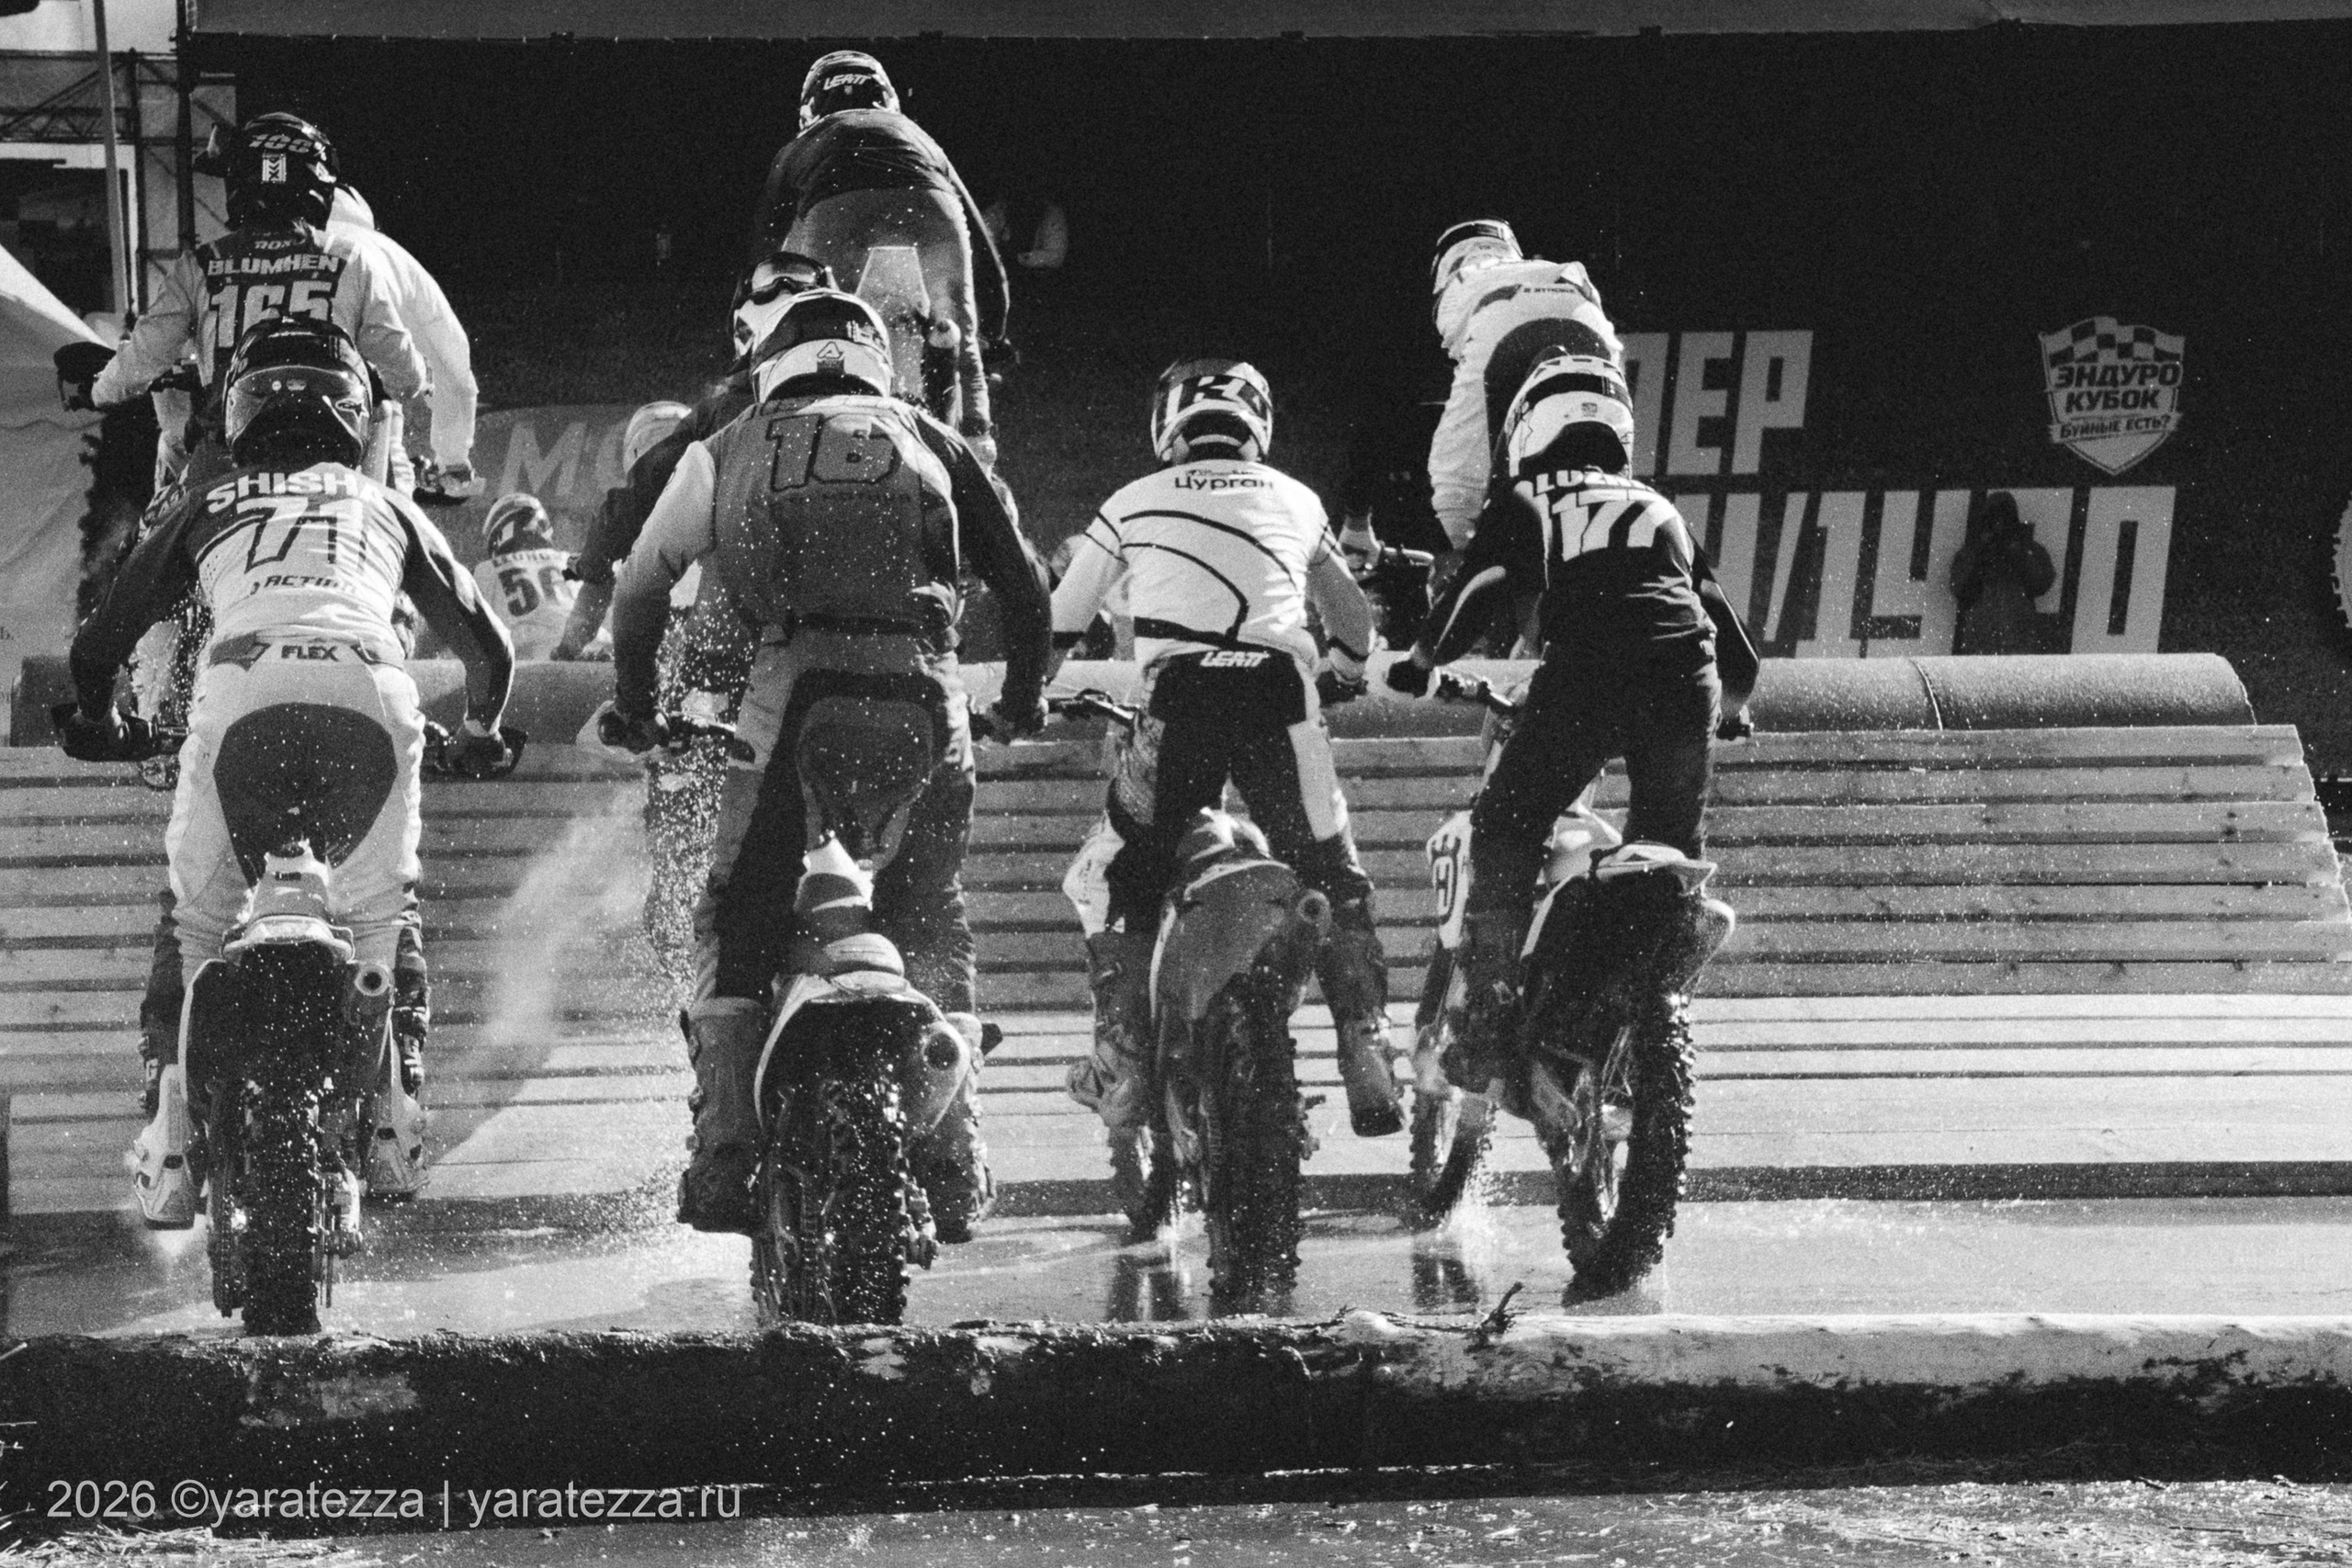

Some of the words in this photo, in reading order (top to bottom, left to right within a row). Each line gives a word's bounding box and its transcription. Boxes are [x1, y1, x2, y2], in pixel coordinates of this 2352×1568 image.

[823, 73, 872, 91] LEATT
[207, 253, 341, 276] BLUMHEN
[210, 280, 334, 347] 165
[2052, 363, 2181, 389] ЭНДУРО
[2064, 389, 2160, 413] КУБОК
[765, 412, 902, 492] 16
[1174, 476, 1274, 491] Цурган
[236, 496, 368, 575] 71
[281, 645, 340, 662] FLEX
[1200, 650, 1271, 668] LEATT
